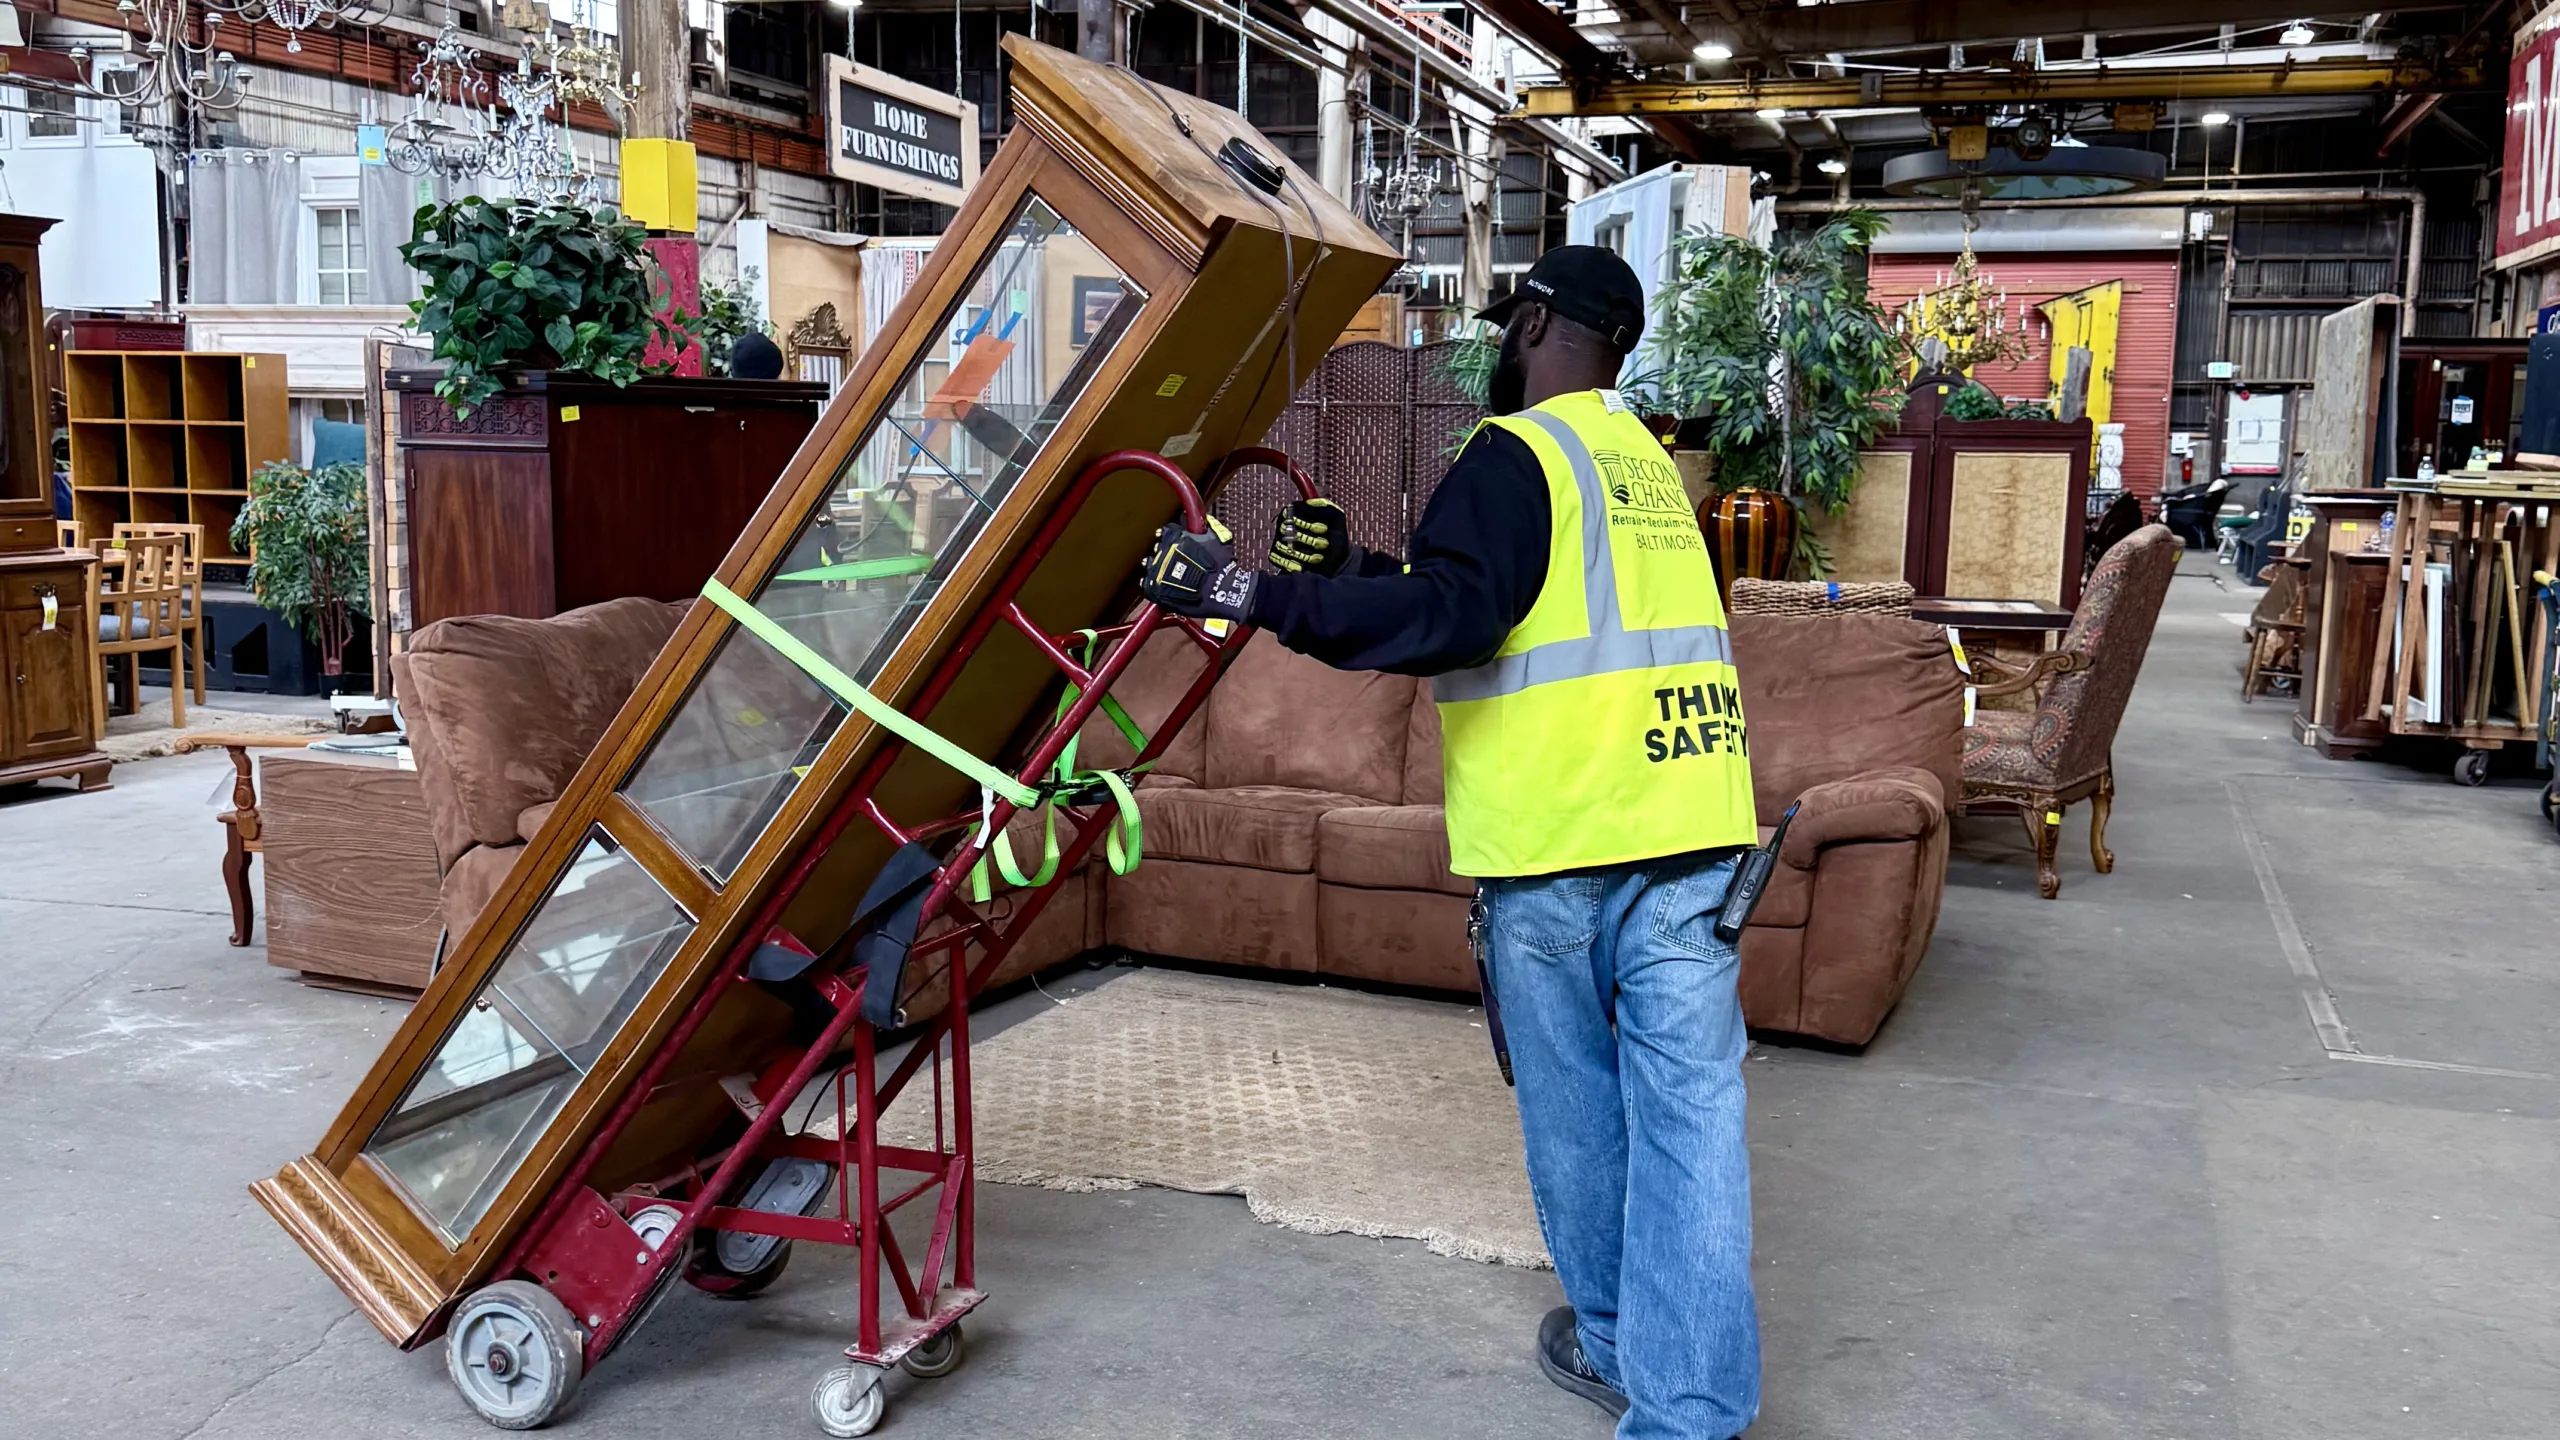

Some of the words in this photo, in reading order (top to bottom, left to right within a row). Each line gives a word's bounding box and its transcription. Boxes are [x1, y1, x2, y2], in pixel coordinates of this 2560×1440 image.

[873, 101, 928, 140] HOME
[841, 124, 959, 181] FURNISHINGS
[1631, 481, 1691, 512] CHANC
[1635, 532, 1701, 551] BALTIMORE
[1645, 720, 1747, 763] SAFETY
